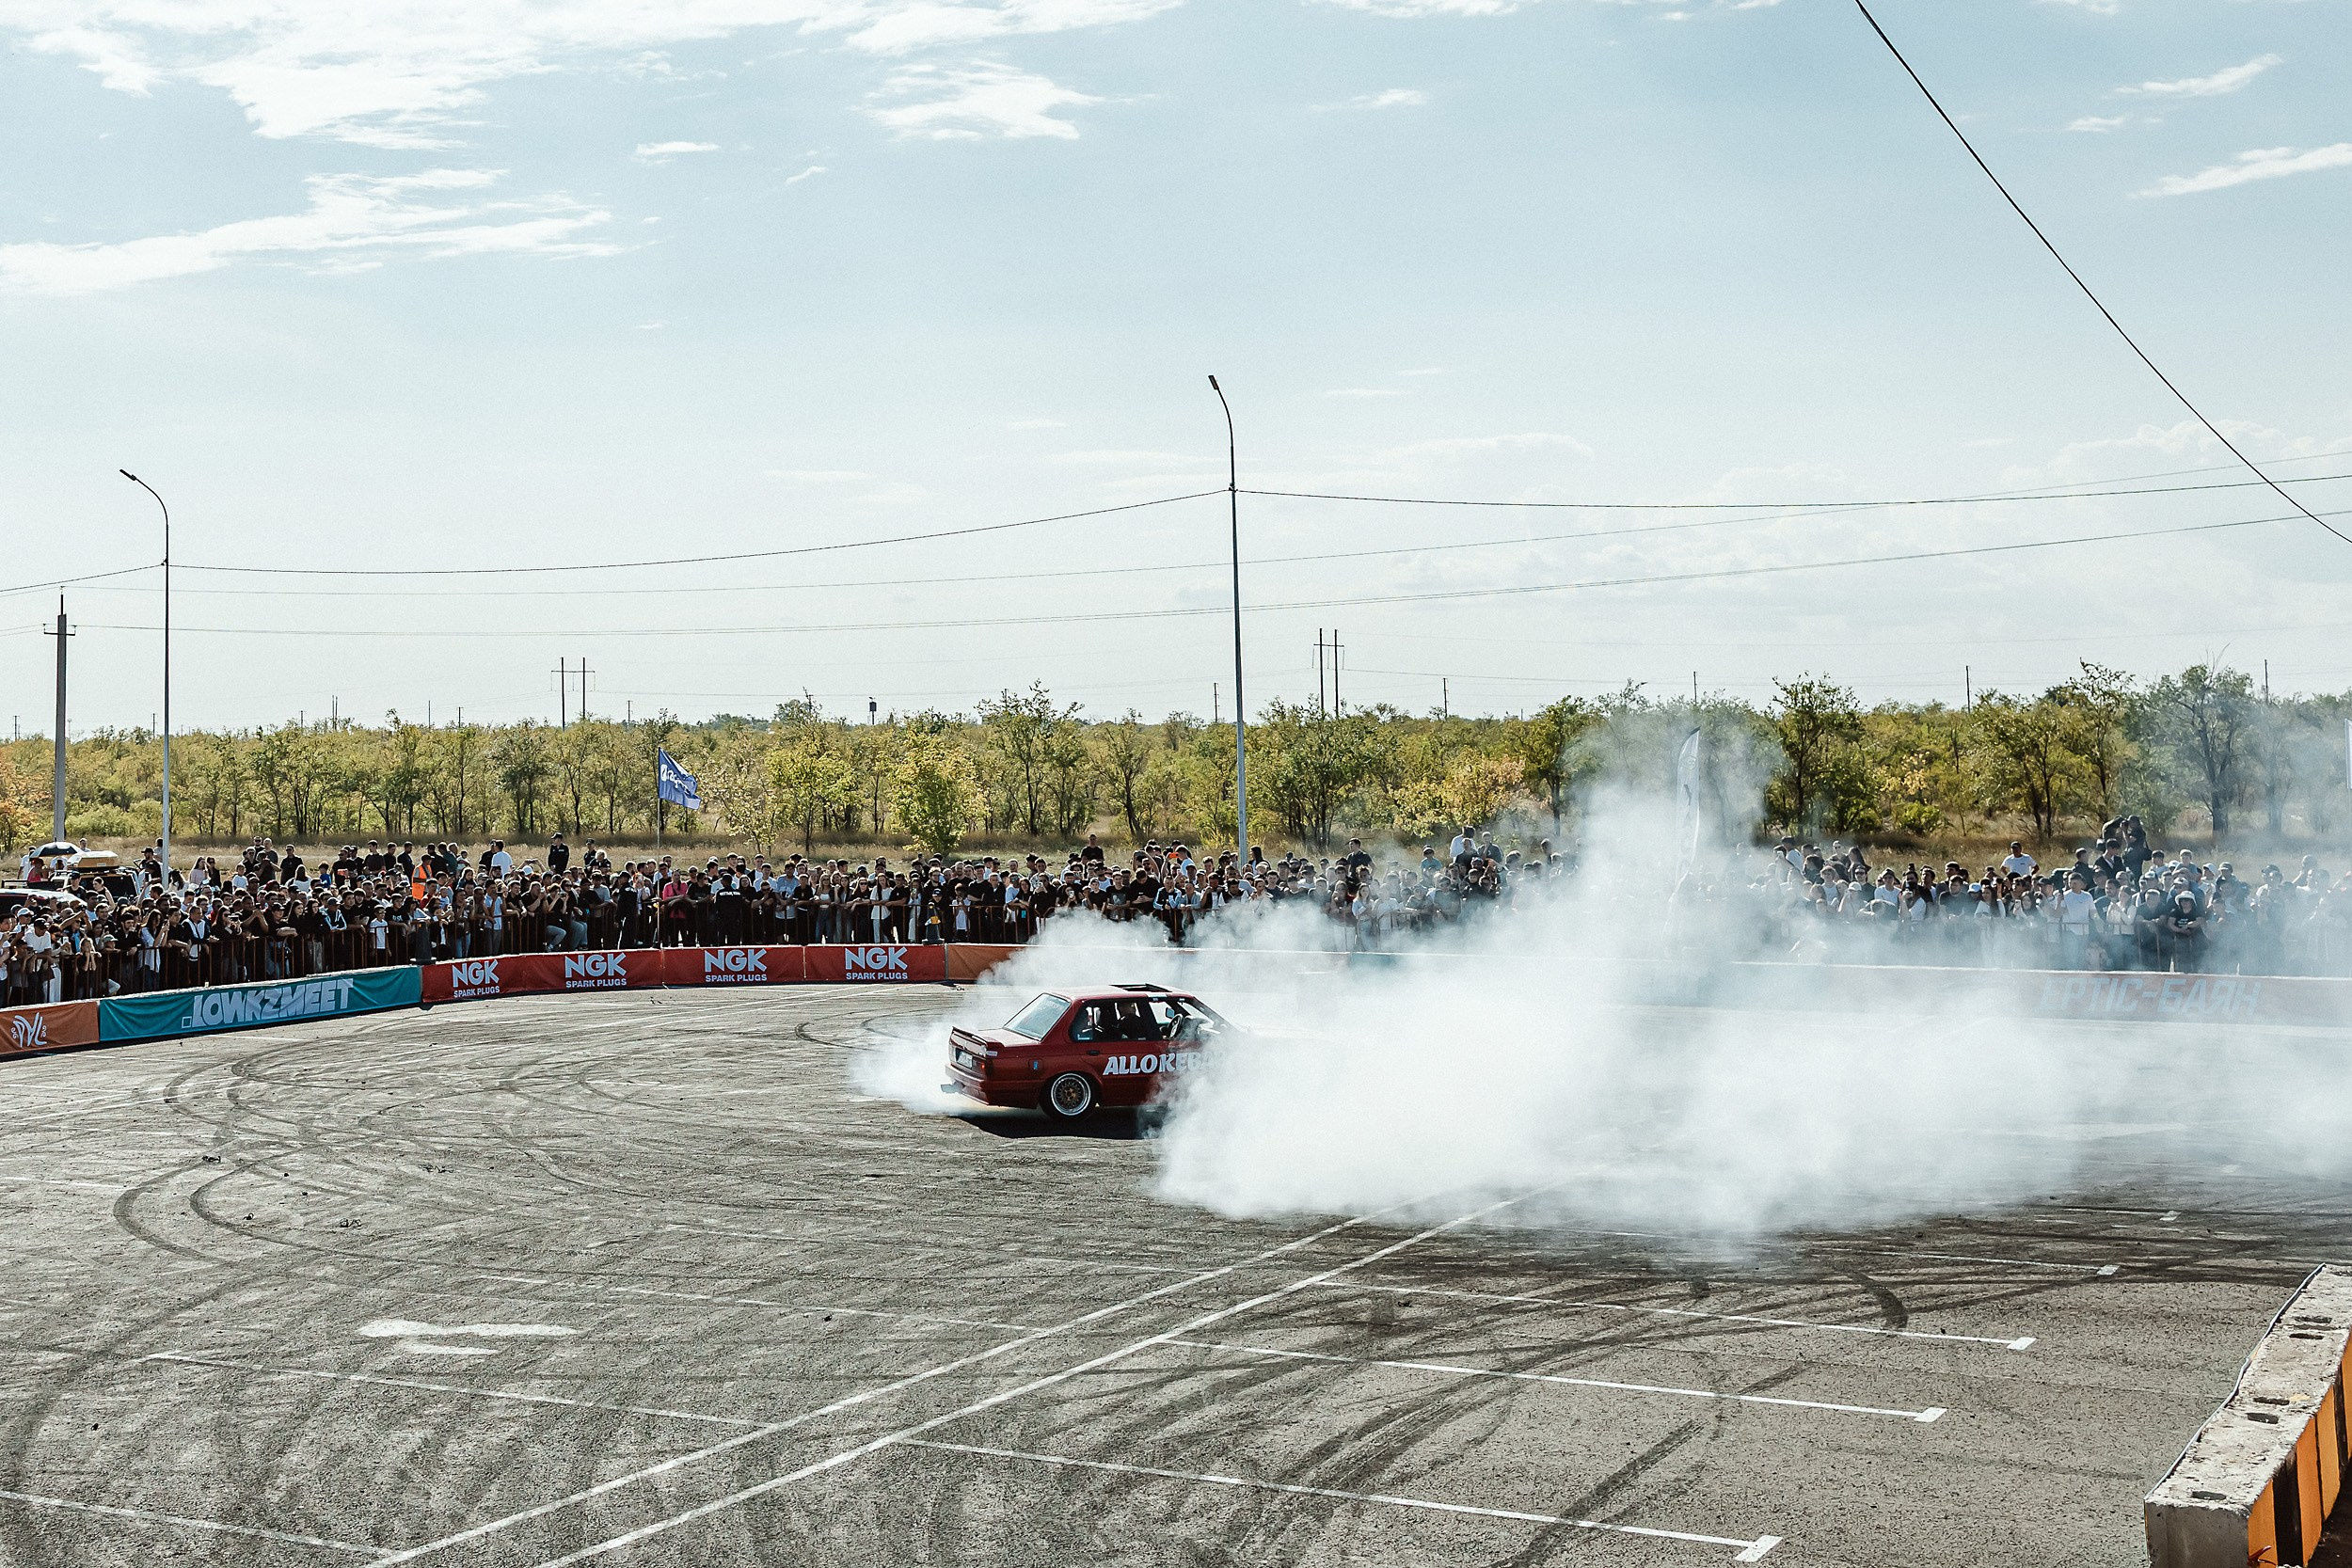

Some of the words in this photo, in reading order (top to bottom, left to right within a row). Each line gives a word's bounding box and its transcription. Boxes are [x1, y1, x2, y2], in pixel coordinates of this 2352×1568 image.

[564, 952, 628, 978] NGK
[704, 948, 768, 973] NGK
[845, 946, 908, 971] NGK
[452, 959, 501, 988] NGK
[737, 974, 768, 982] PLUGS
[846, 972, 876, 980] SPARK
[878, 972, 908, 980] PLUGS
[453, 989, 476, 998] SPARK
[477, 986, 501, 996] PLUGS
[565, 979, 596, 989] SPARK
[596, 978, 628, 988] PLUGS
